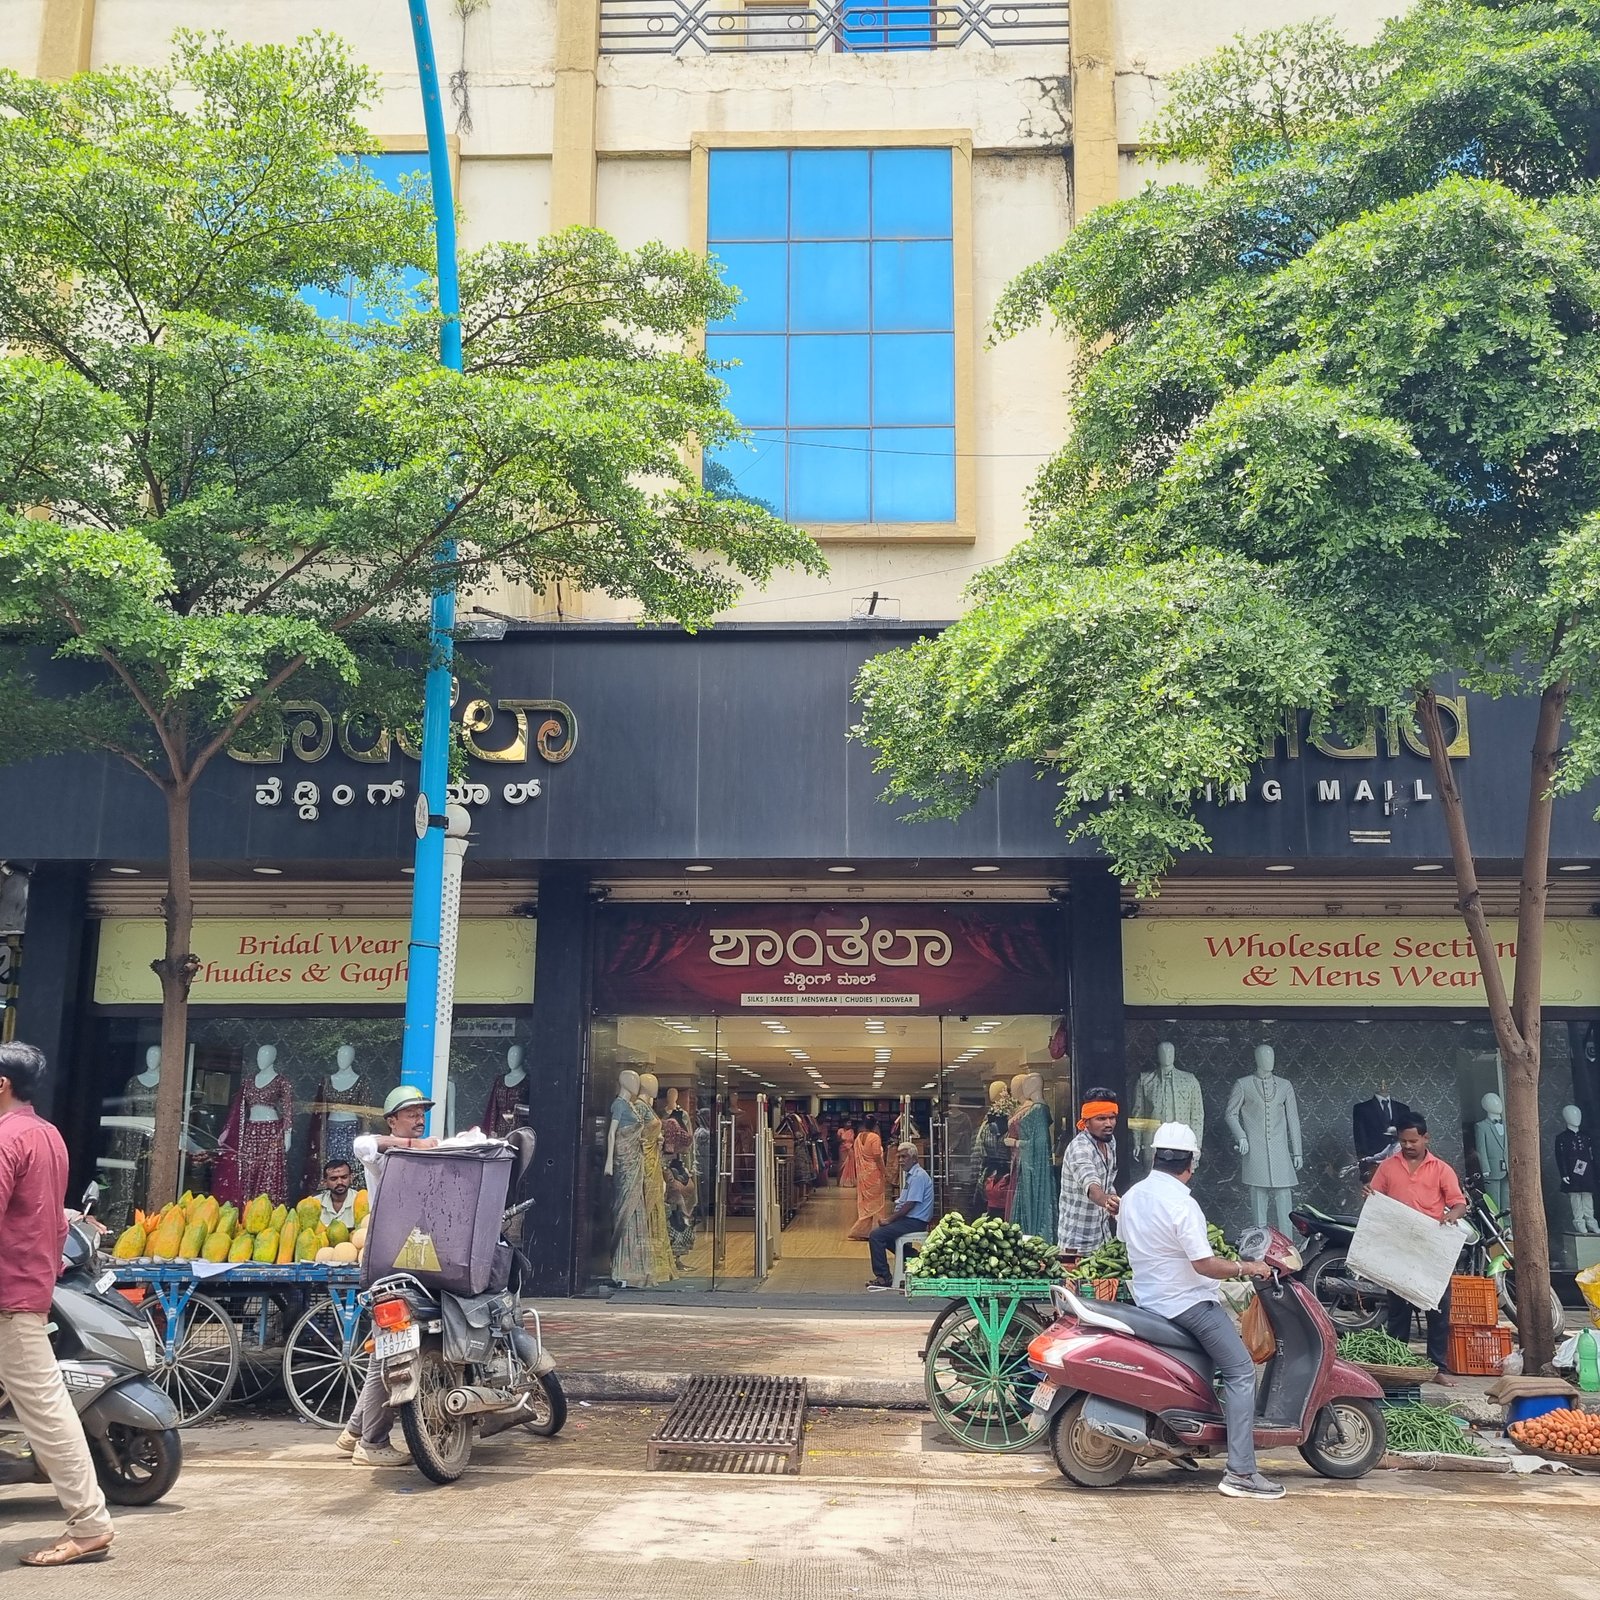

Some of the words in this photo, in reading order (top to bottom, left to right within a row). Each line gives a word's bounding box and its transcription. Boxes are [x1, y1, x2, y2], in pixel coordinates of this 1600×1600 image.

[237, 932, 325, 955] Bridal
[328, 935, 403, 955] Wear
[708, 916, 953, 967] ಶಾಂತಲಾ
[1204, 933, 1382, 959] Wholesale
[1392, 934, 1517, 959] Sectin
[301, 963, 331, 983] &
[340, 960, 408, 991] Gagh
[783, 972, 832, 991] ವೆಡ್ಡಿಂಗ್
[837, 972, 876, 986] ಮಾಲ್
[1242, 965, 1279, 988] &
[1289, 965, 1381, 988] Mens
[1389, 965, 1482, 988] Wear
[747, 995, 764, 1003] SILKS
[770, 995, 794, 1003] SAREES
[801, 995, 838, 1003] MENSWEAR
[845, 995, 873, 1003] CHUDIES
[880, 995, 913, 1003] KIDSWEAR
